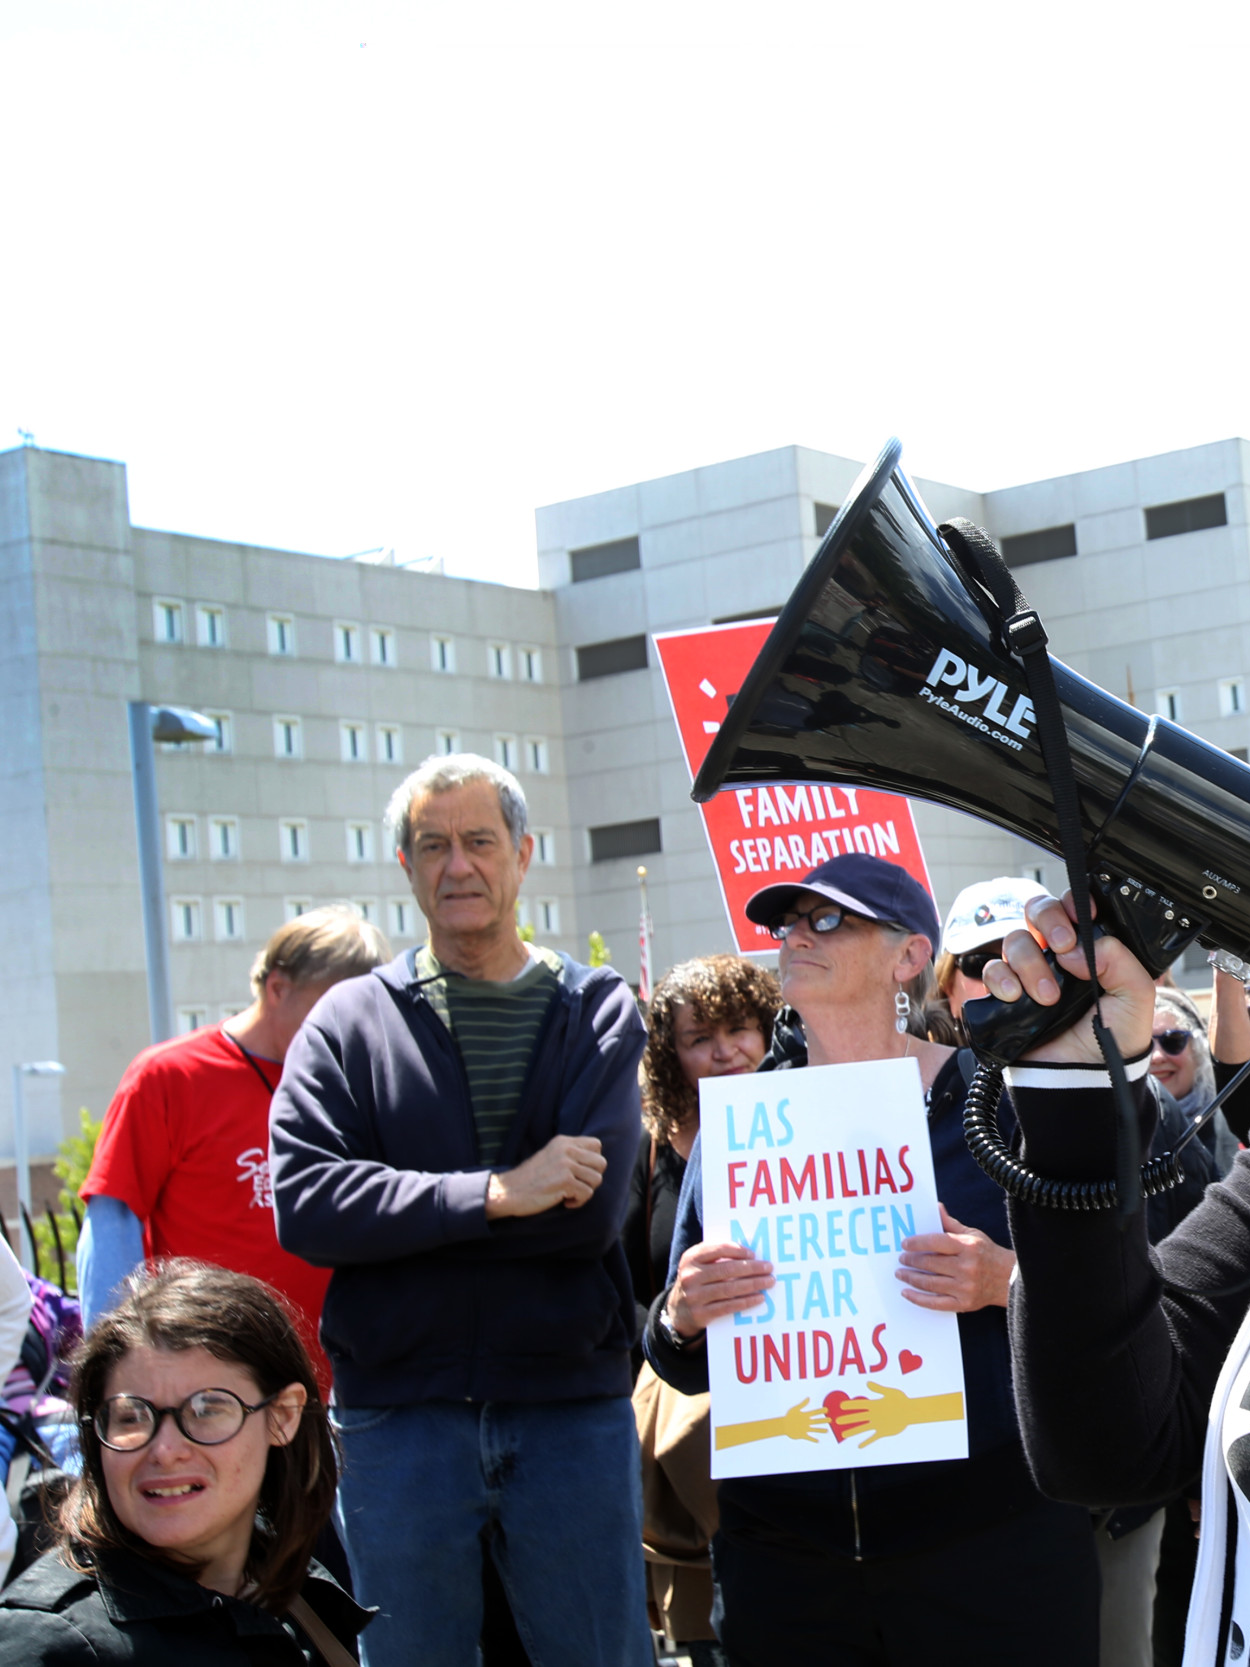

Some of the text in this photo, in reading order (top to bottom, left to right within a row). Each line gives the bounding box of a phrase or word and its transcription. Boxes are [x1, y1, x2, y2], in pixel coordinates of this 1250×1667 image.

[919, 686, 1023, 751] PyleAudio.com
[926, 647, 1038, 739] PYLE
[735, 785, 859, 828] FAMILY
[730, 820, 900, 874] SEPARATION
[1159, 896, 1174, 908] TALK
[1202, 869, 1241, 895] AUX/MP3
[726, 1098, 794, 1152] LAS
[728, 1145, 914, 1208] FAMILIAS
[730, 1203, 917, 1264] MERECEN
[733, 1268, 858, 1326] STAR
[734, 1322, 888, 1384] UNIDAS
